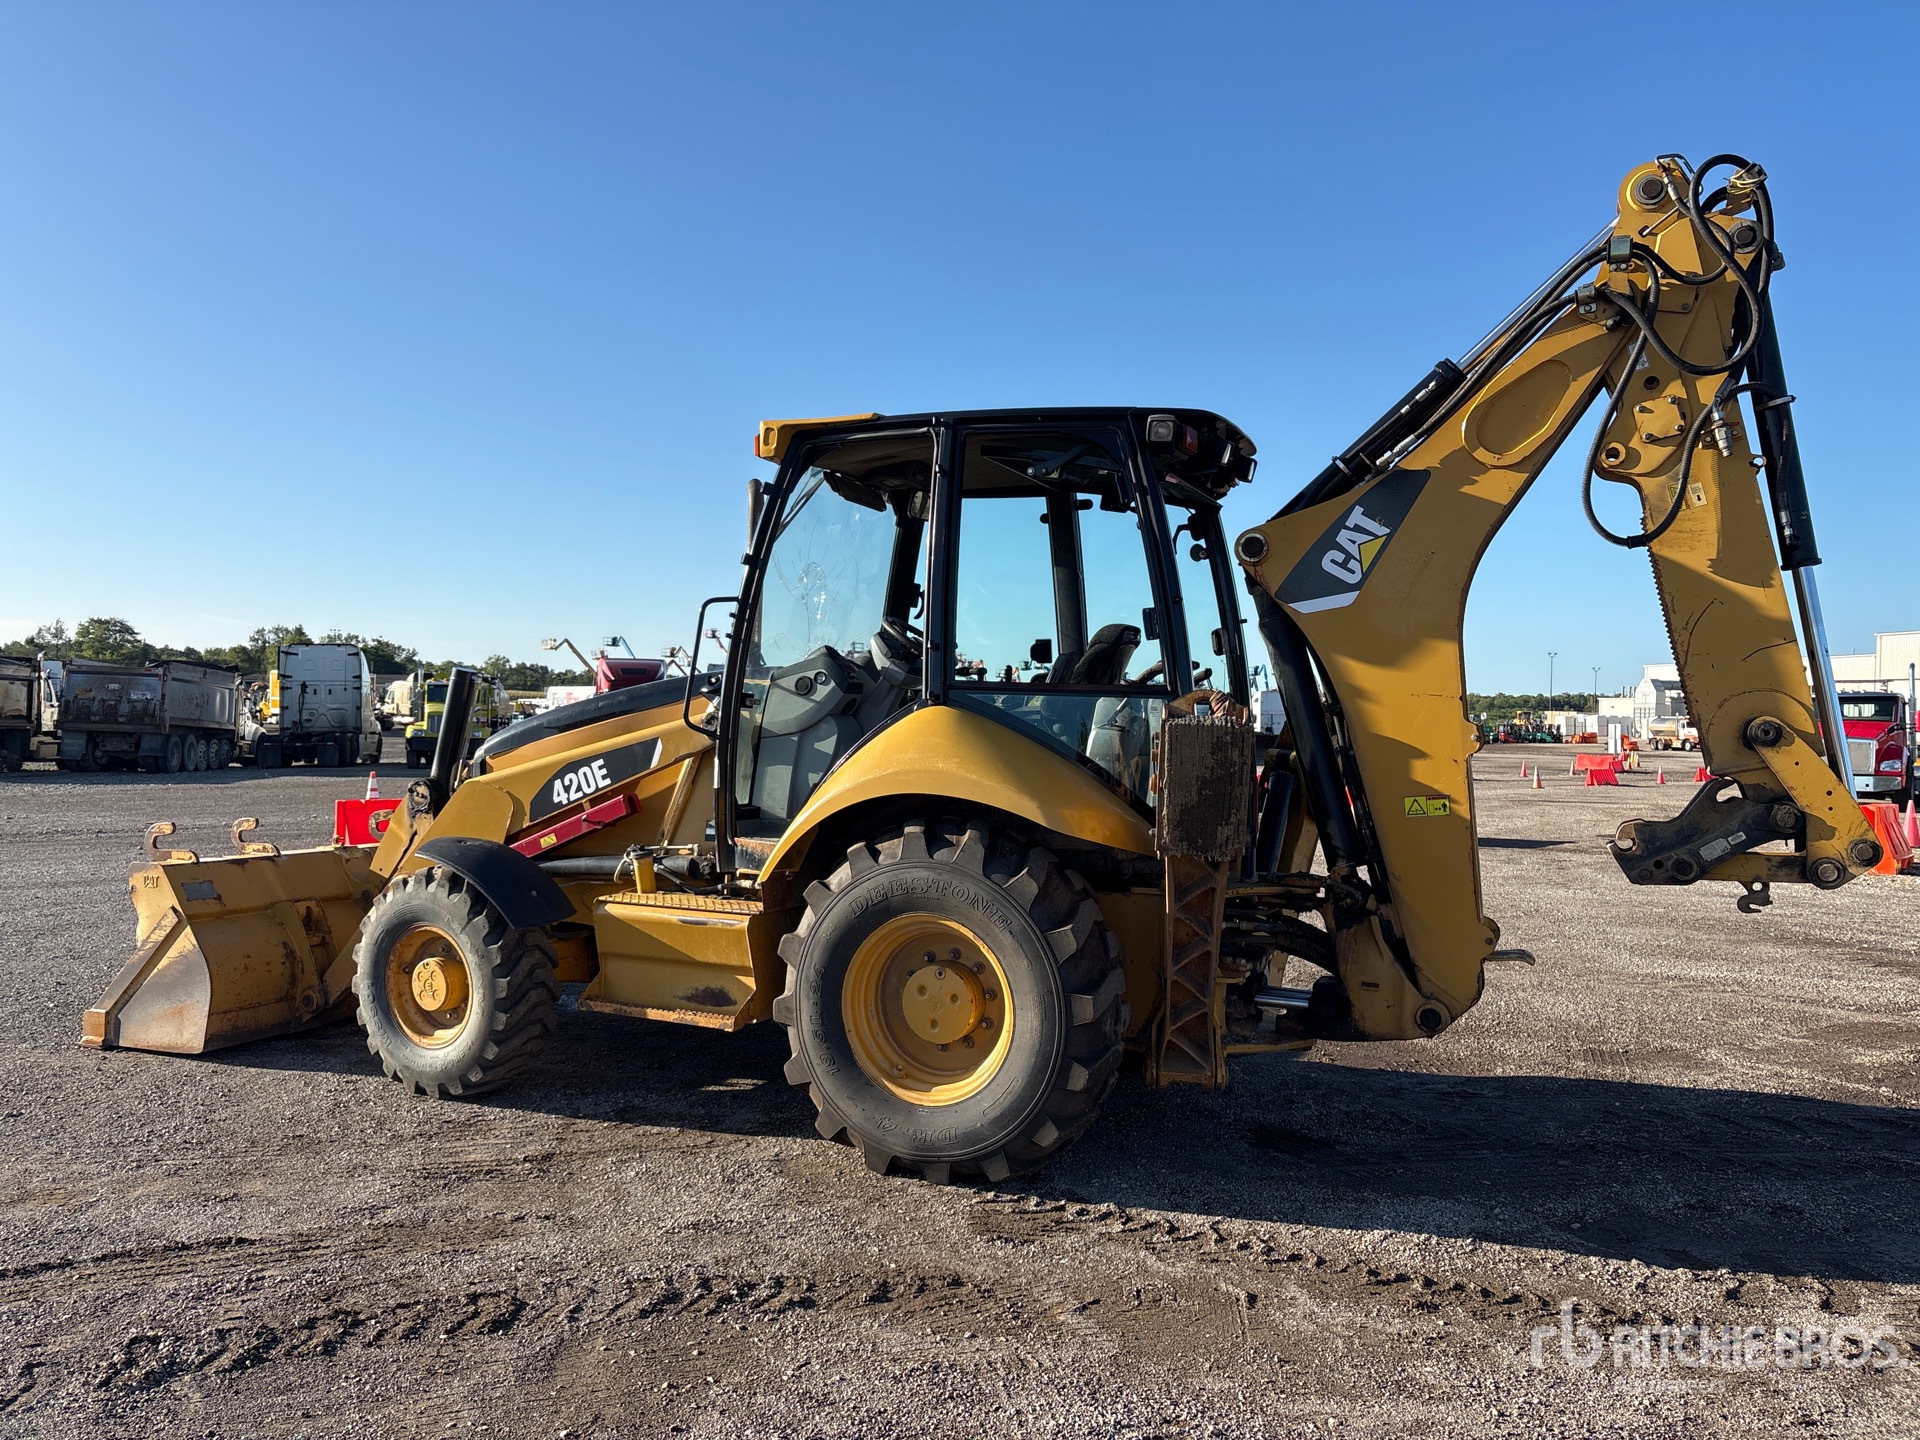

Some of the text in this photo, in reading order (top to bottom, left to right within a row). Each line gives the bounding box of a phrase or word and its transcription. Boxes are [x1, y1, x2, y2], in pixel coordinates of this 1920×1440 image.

[1321, 505, 1391, 585] CAT
[552, 758, 612, 805] 420E
[143, 875, 159, 888] CAT
[848, 876, 1012, 931] DEESTONE
[809, 963, 841, 1077] 19.5L-24
